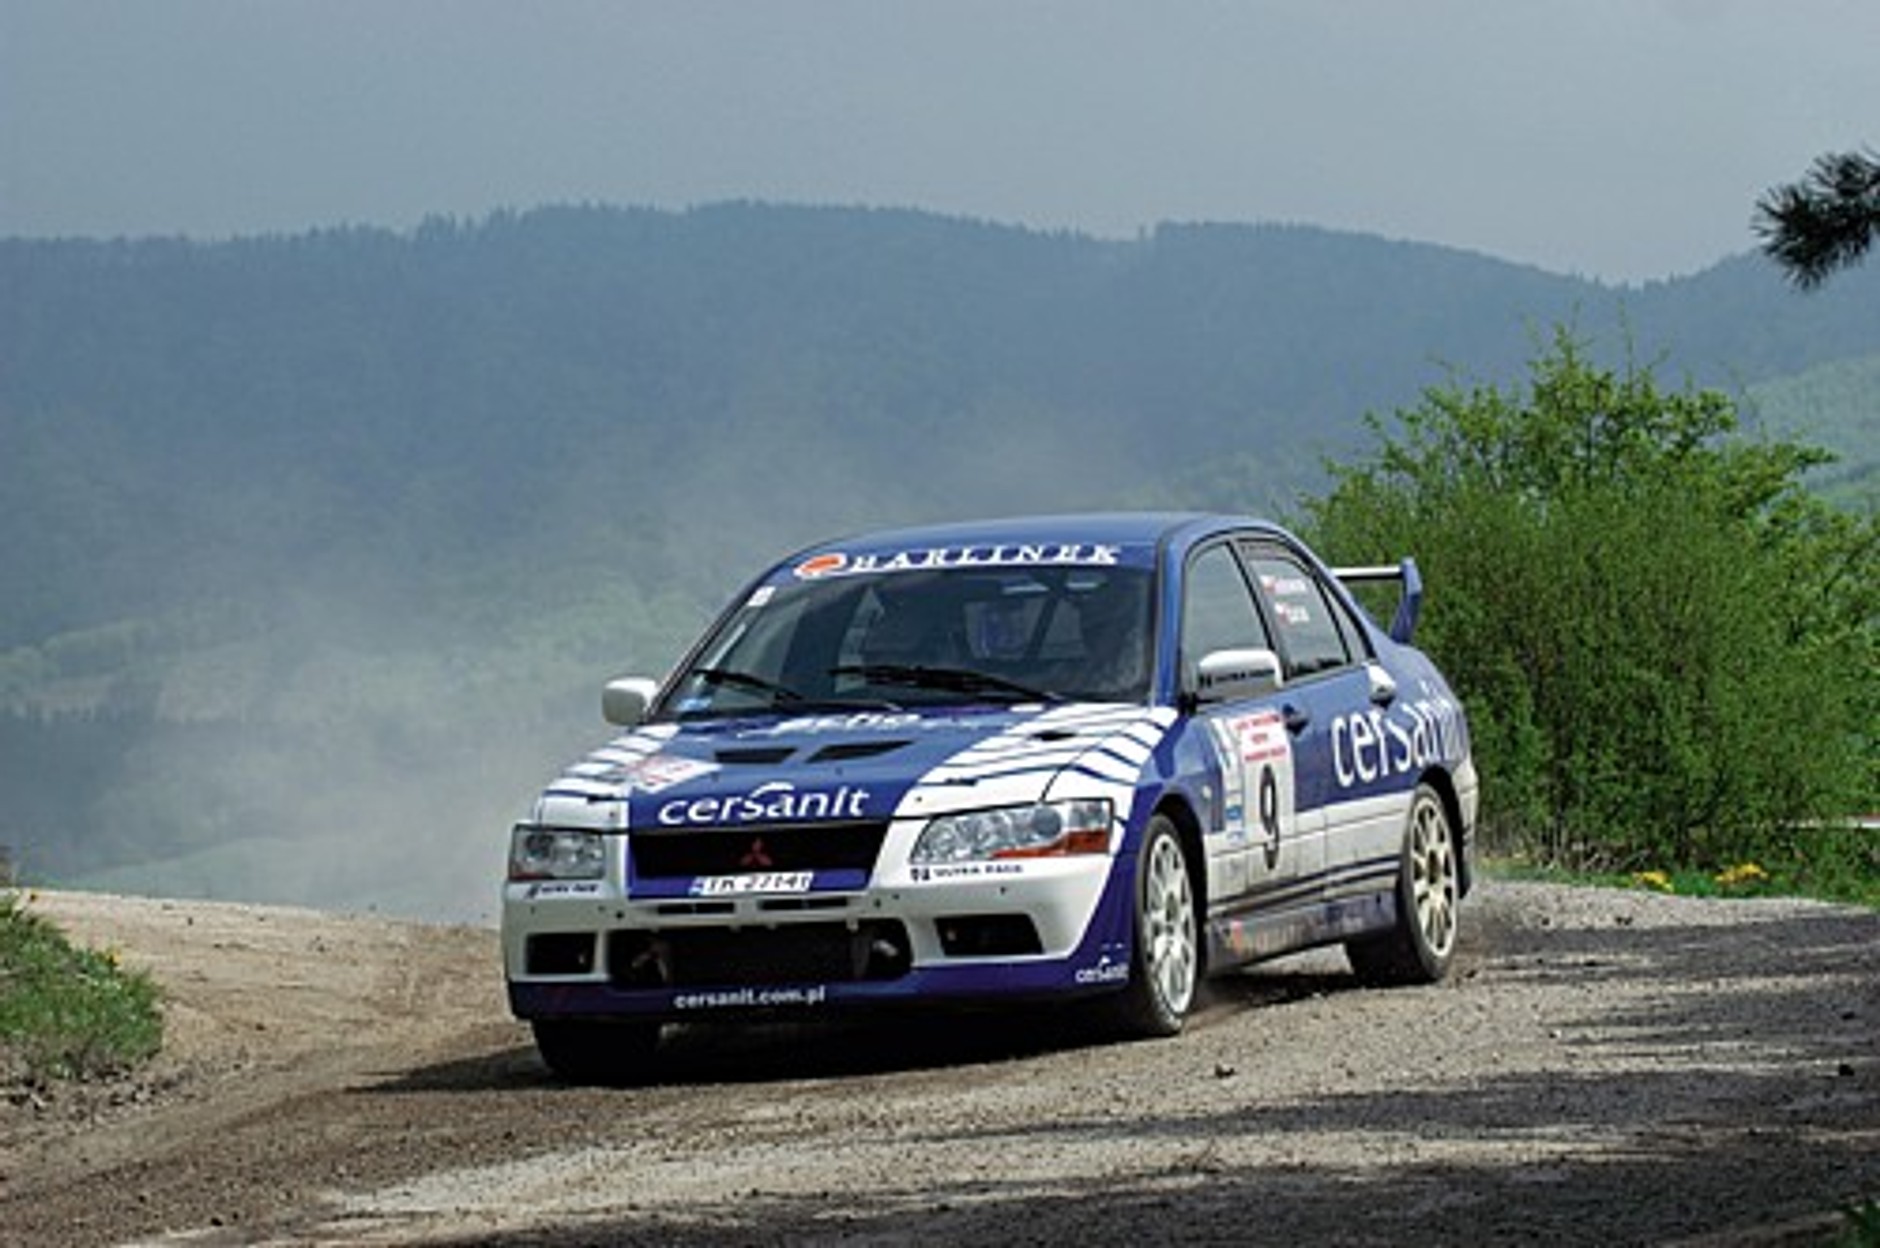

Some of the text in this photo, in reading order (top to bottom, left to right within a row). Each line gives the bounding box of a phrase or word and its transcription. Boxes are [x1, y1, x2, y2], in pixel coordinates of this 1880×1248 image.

[657, 782, 871, 826] cersanit
[1259, 764, 1281, 871] 9
[674, 984, 825, 1007] cersanit.com.pl
